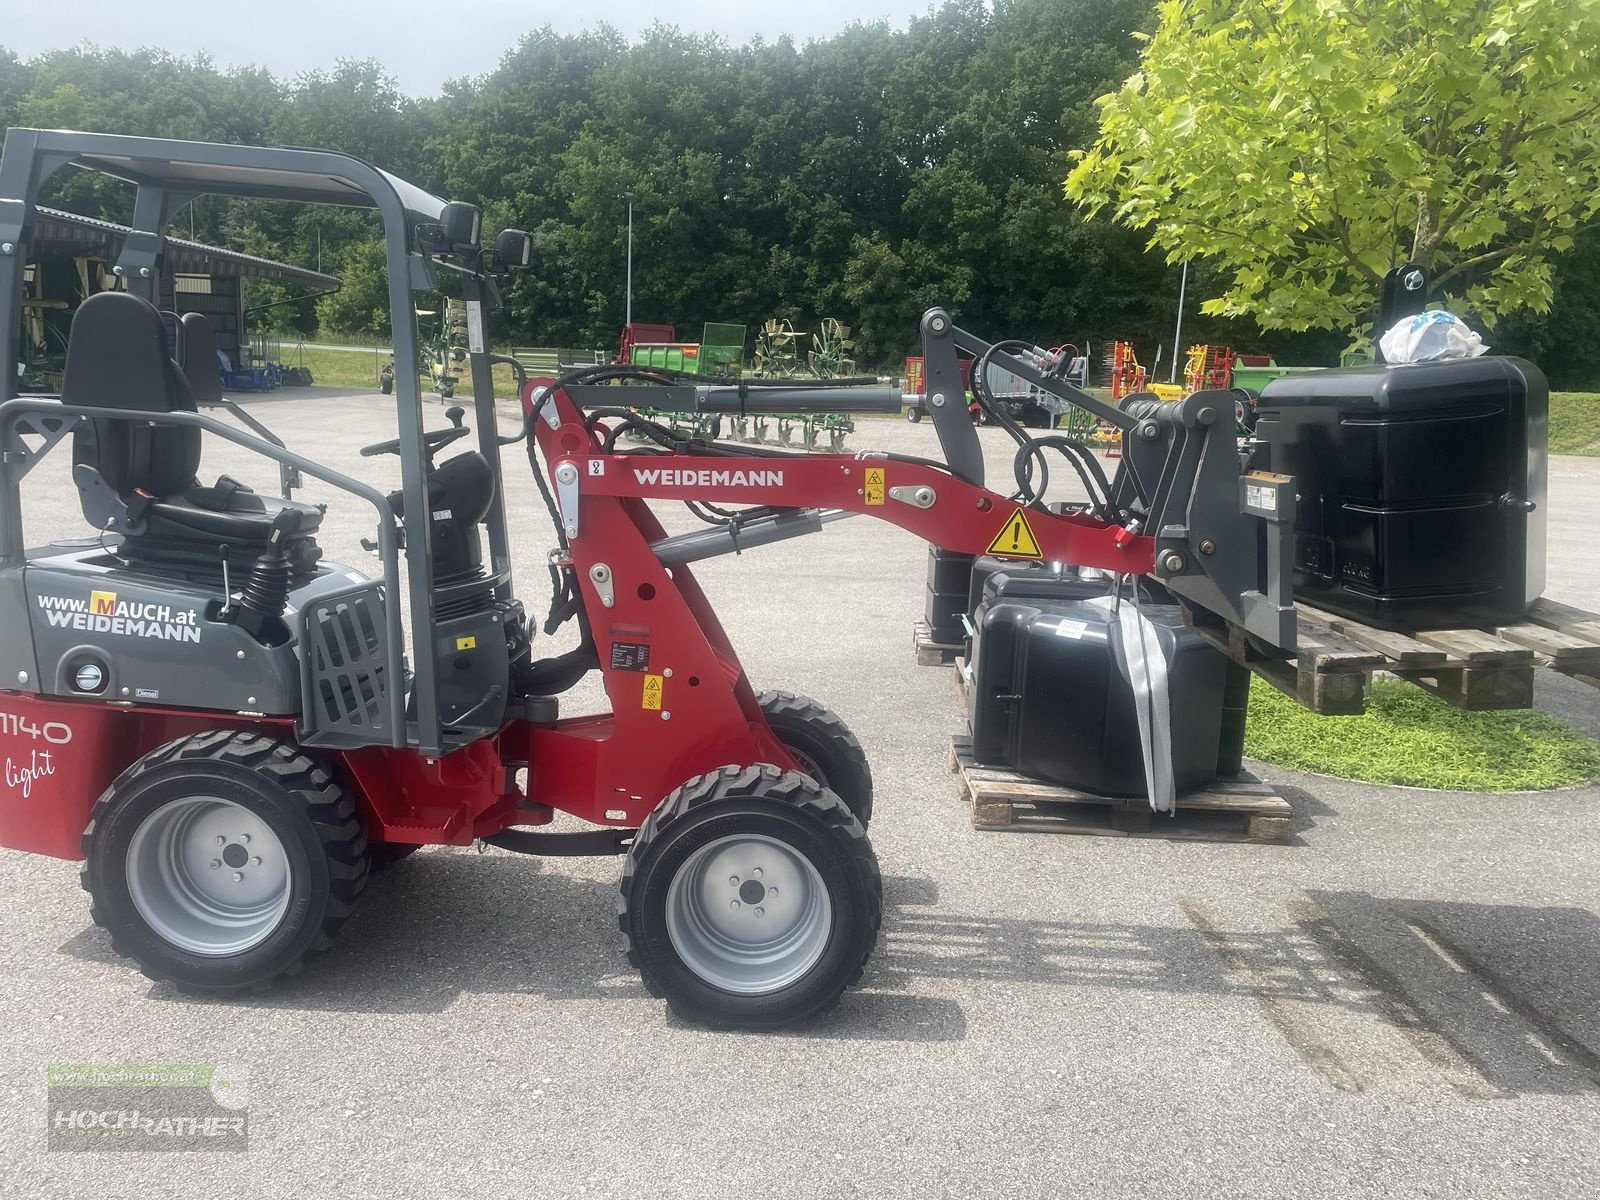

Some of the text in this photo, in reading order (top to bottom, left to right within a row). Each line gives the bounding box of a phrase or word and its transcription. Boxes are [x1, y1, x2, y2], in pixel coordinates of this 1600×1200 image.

[633, 468, 784, 487] WEIDEMANN
[46, 609, 201, 643] WEIDEMANN
[0, 712, 72, 744] 1140
[6, 749, 55, 798] light
